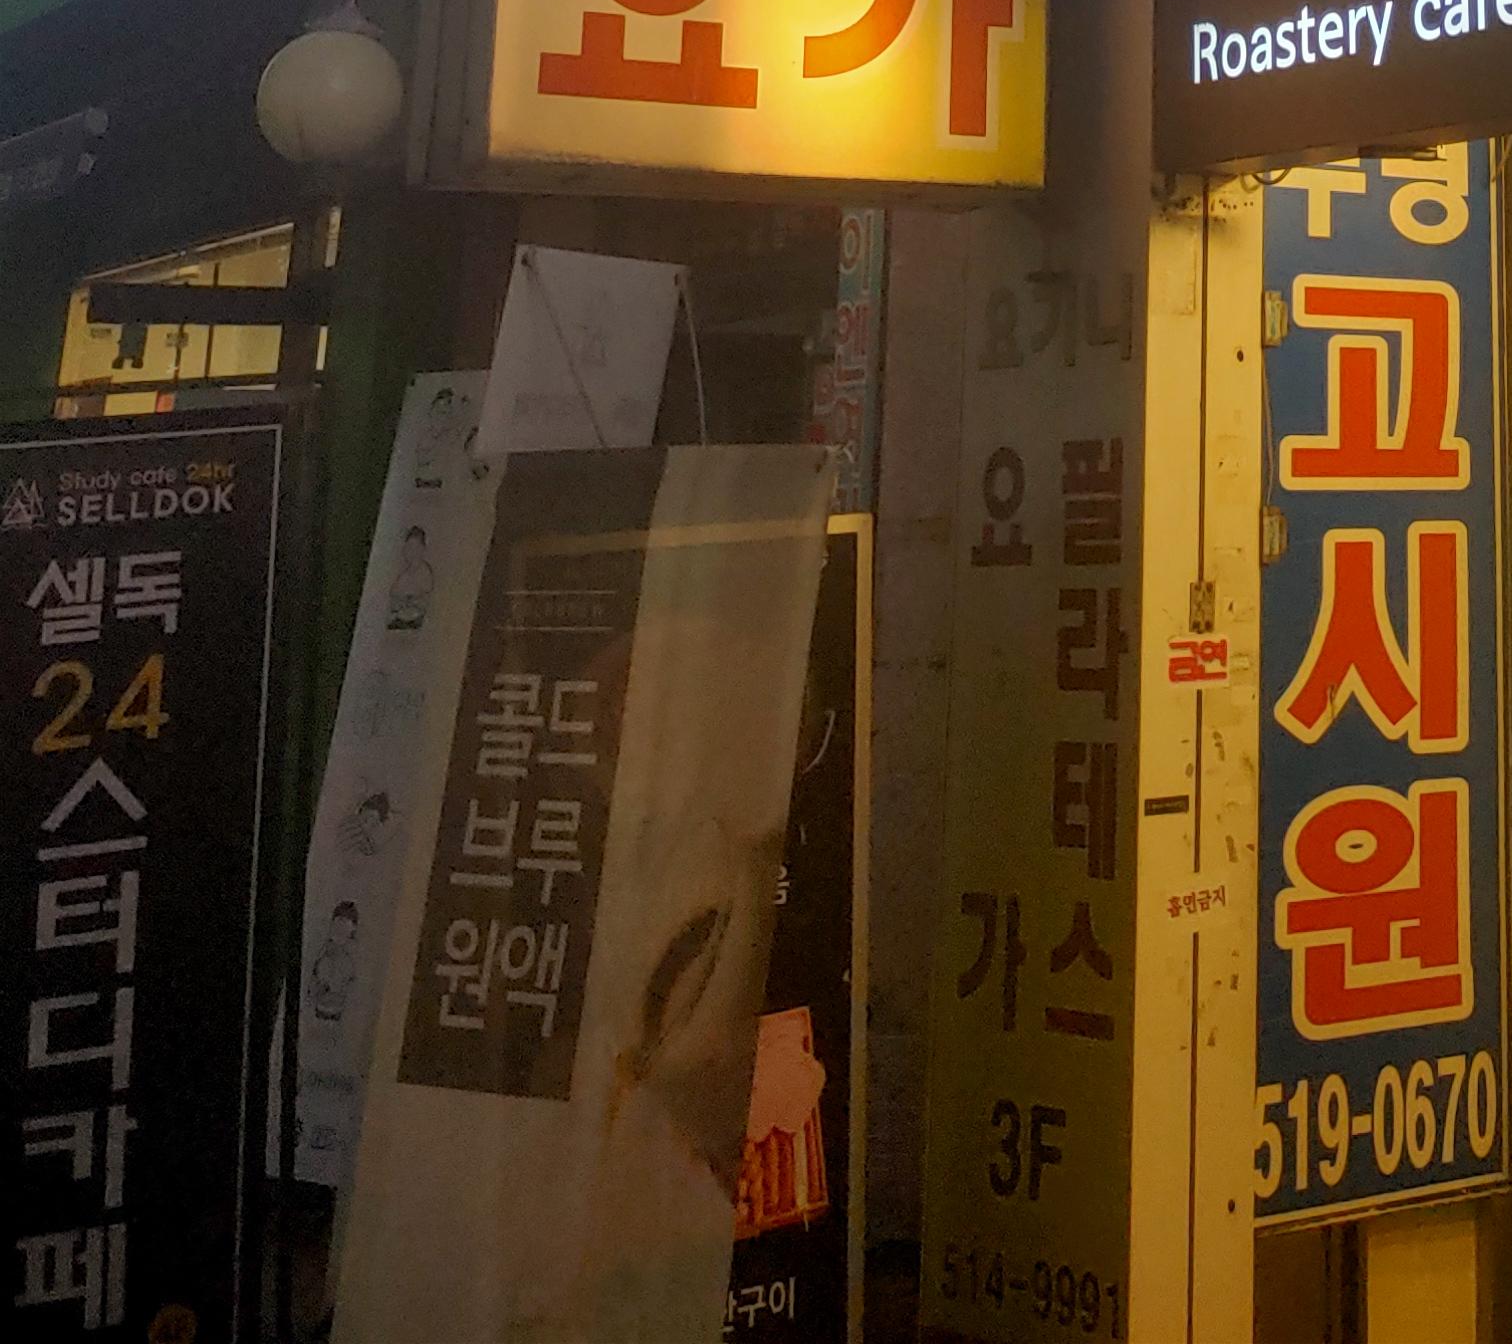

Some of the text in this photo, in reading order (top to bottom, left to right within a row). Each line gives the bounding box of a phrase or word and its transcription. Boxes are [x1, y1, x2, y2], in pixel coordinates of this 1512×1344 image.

[56, 482, 236, 527] SELLDOK
[25, 550, 182, 647] 셀독
[31, 653, 171, 755] 24
[1274, 273, 1474, 1041] 고시원
[477, 673, 599, 780] 콜드
[449, 799, 583, 905] 브루
[1167, 885, 1226, 918] 흡연금지
[435, 918, 569, 1039] 원액
[13, 756, 148, 1331] 스터디카페
[988, 1099, 1066, 1202] 3F
[1254, 1051, 1497, 1199] 519-0670
